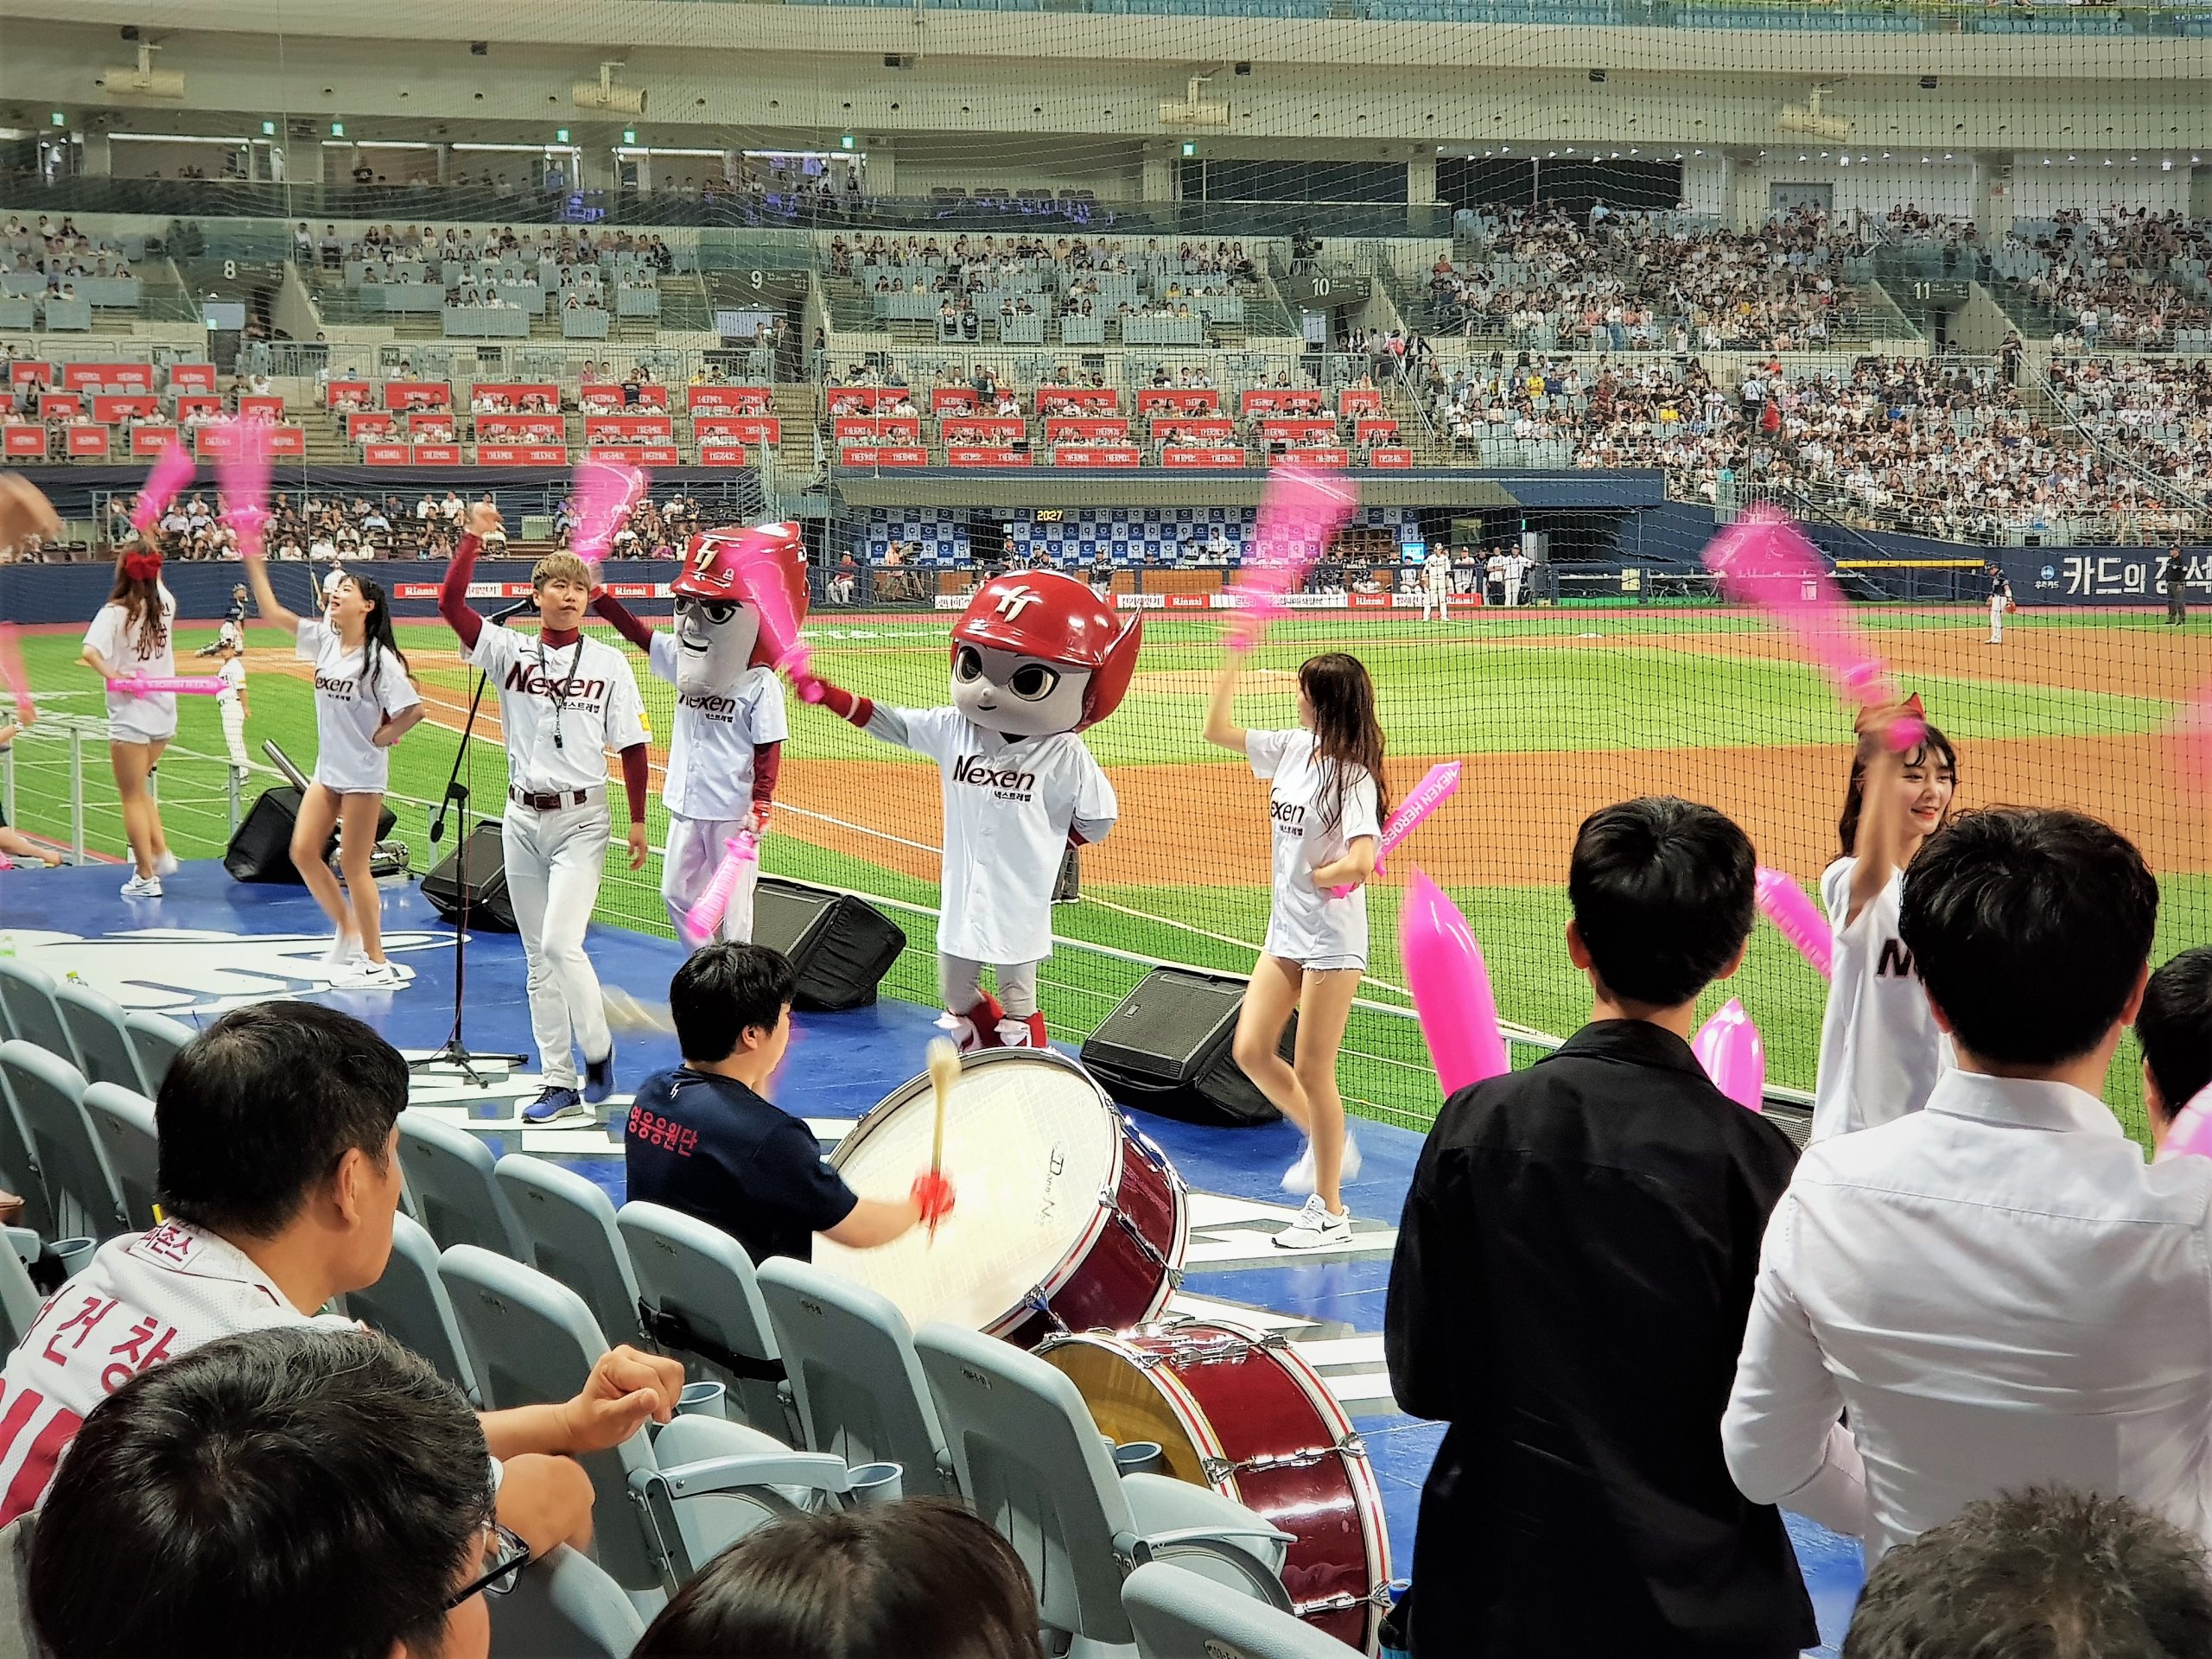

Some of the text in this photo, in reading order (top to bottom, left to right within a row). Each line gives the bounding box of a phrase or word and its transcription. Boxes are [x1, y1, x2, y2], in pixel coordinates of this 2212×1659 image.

[225, 260, 236, 279] 8
[751, 270, 762, 289] 9
[1312, 277, 1330, 296] 10
[1914, 282, 1930, 300] 11
[2063, 556, 2146, 595] 카드의
[615, 587, 646, 595] Rinnai
[1355, 595, 1384, 605] Rinnai
[1173, 597, 1203, 606] Rinnai
[315, 677, 353, 693] exen
[505, 660, 604, 700] Nexen
[952, 754, 1035, 791] Nexen
[1270, 800, 1305, 823] exen
[1382, 767, 1459, 846] NEXEN HEROES
[1878, 938, 1918, 977] N
[628, 1105, 698, 1158] 영웅응원단
